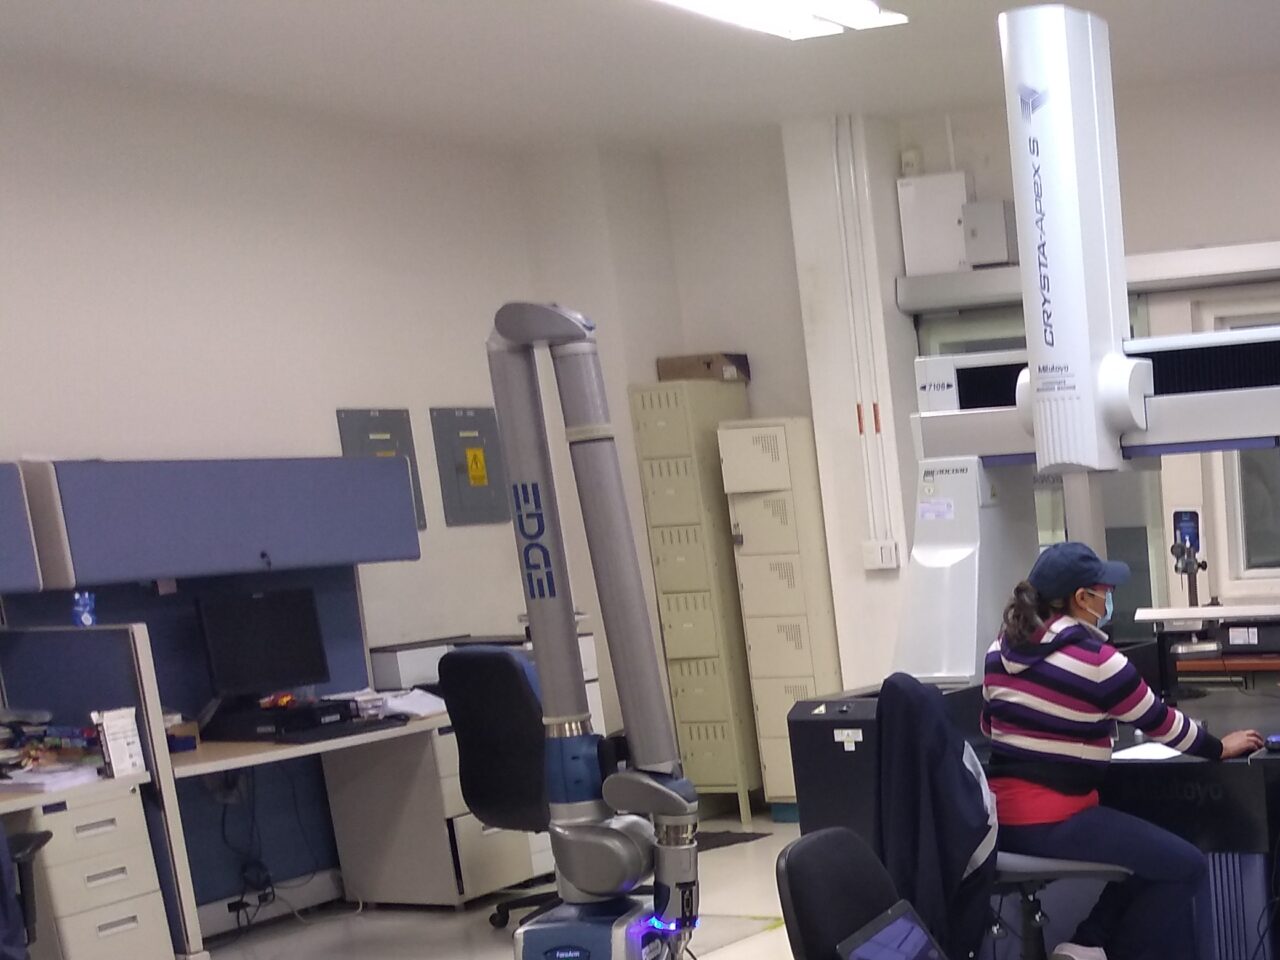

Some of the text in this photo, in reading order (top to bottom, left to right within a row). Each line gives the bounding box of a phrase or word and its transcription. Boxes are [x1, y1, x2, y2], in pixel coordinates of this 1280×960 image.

[1029, 138, 1040, 157] S
[1037, 365, 1069, 375] Mitutoyo
[513, 482, 557, 600] EDGE
